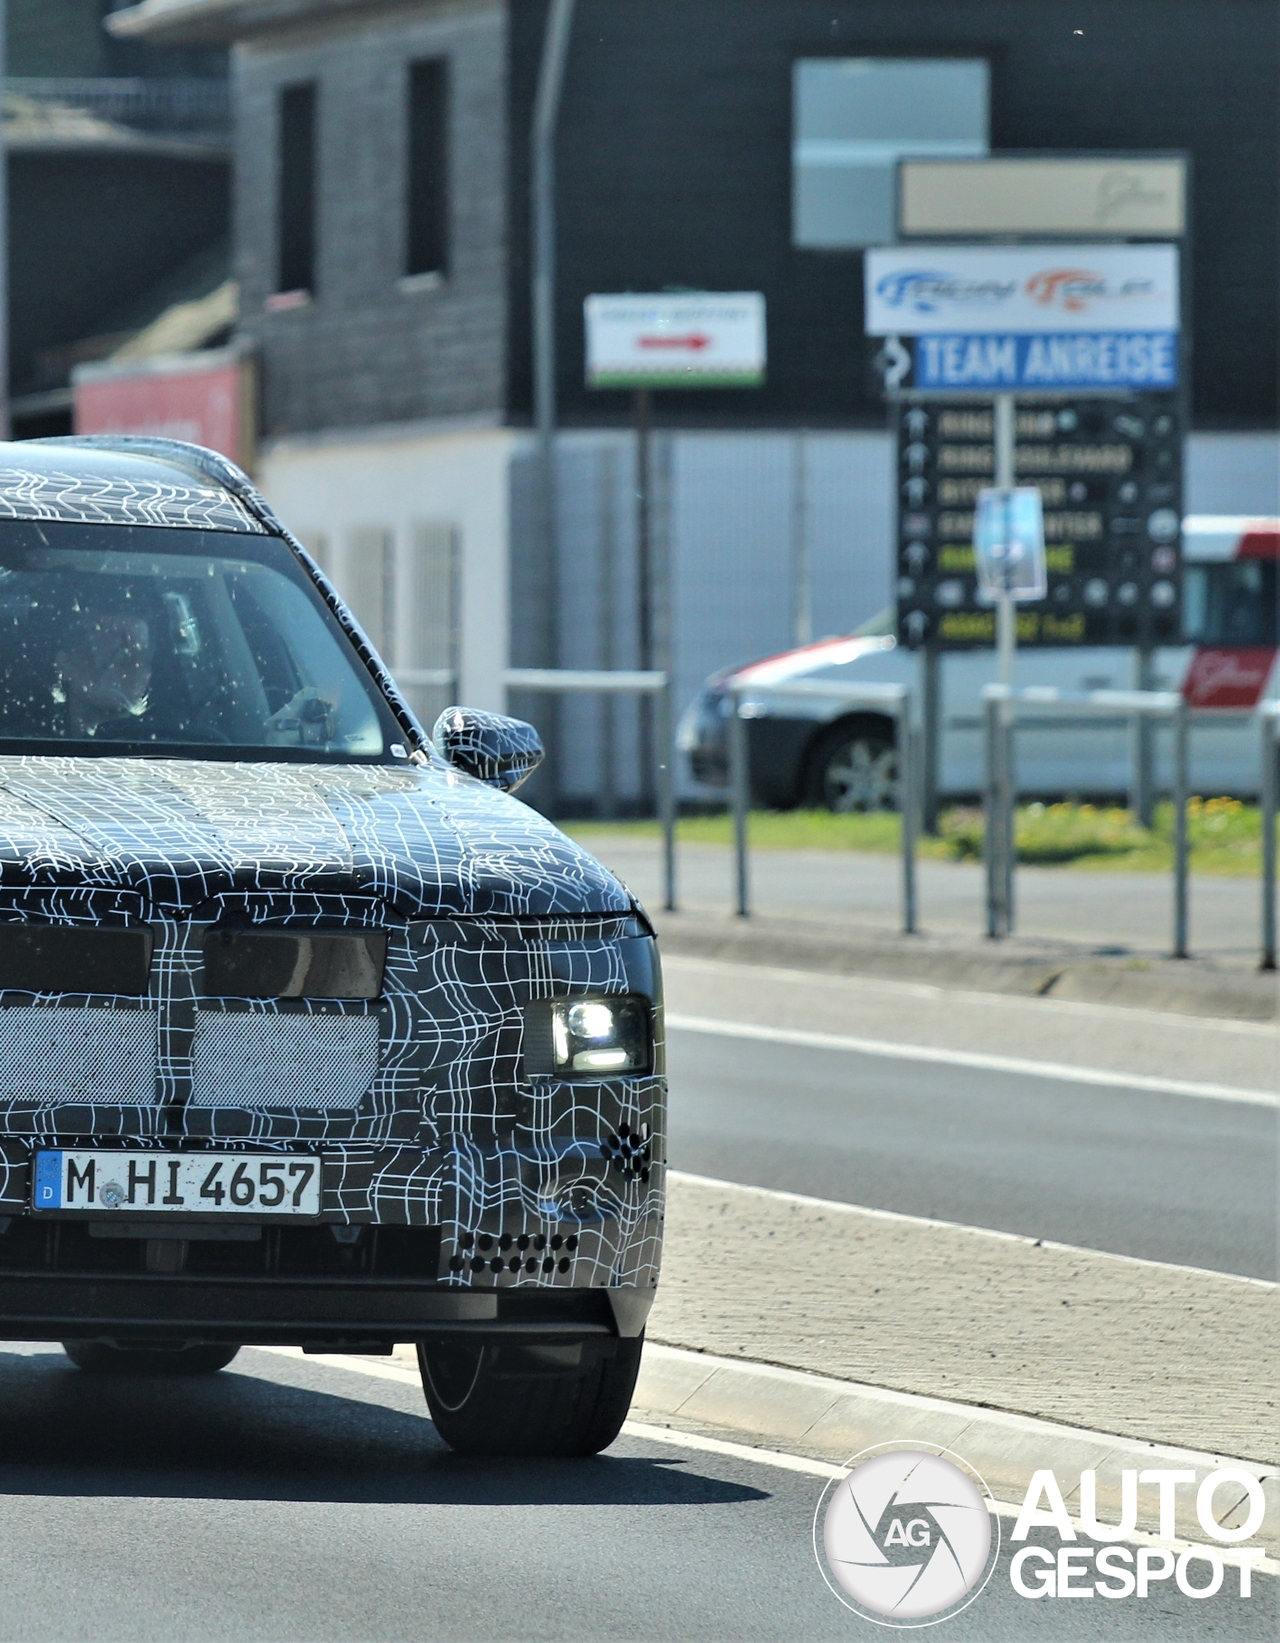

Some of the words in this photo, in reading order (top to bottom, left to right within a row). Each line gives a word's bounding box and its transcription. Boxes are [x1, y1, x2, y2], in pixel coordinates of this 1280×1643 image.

[924, 337, 1017, 382] TEAM
[1024, 335, 1172, 382] ANREISE
[43, 1186, 53, 1199] D
[67, 1158, 95, 1203] M
[128, 1159, 185, 1205] HI
[199, 1161, 315, 1207] 4657
